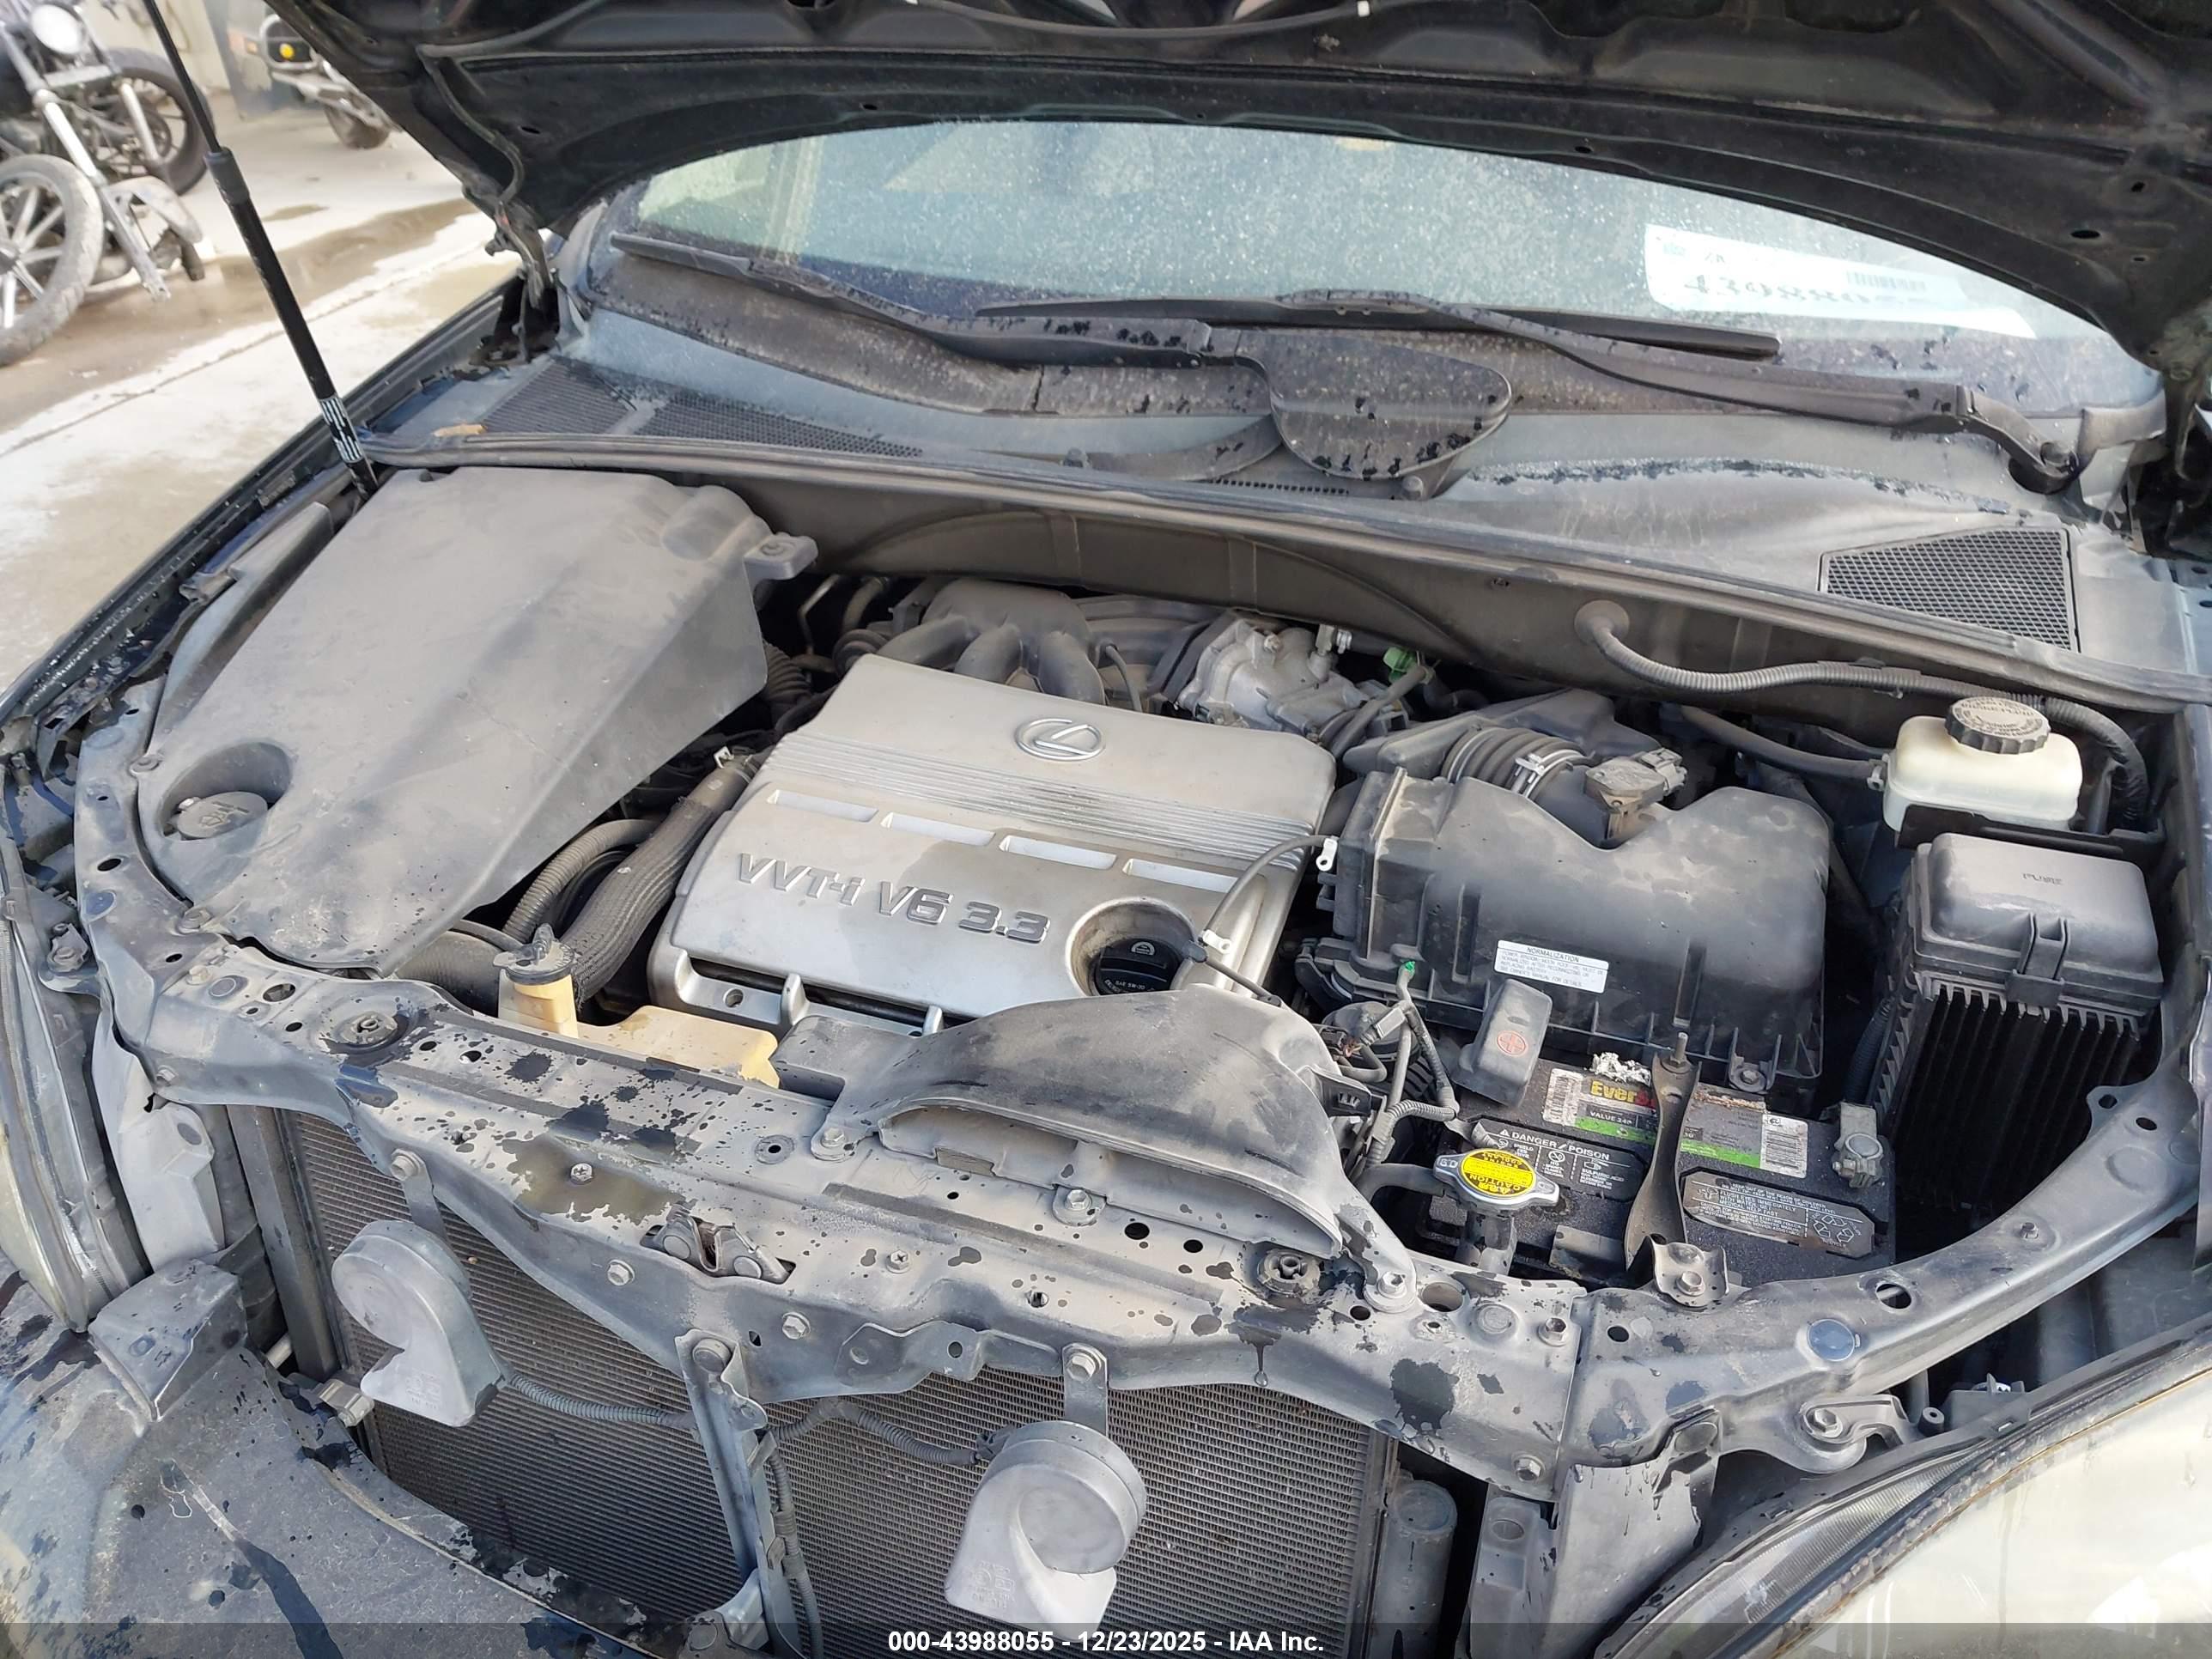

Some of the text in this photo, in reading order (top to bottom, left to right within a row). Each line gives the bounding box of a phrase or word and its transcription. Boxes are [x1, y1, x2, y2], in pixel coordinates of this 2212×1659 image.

[738, 853, 1051, 944] VVT-i V6 3.3
[1527, 947, 1579, 963] NORMALIZATION
[1590, 1111, 1615, 1121] VALUE
[1511, 1132, 1557, 1148] DANGER
[1568, 1146, 1610, 1160] POISON
[1482, 1152, 1523, 1165] COOLANT
[1469, 1174, 1521, 1191] CAUTION
[1719, 1200, 1744, 1208] MEDICAL
[1756, 1200, 1796, 1212] IMMEDIATELY
